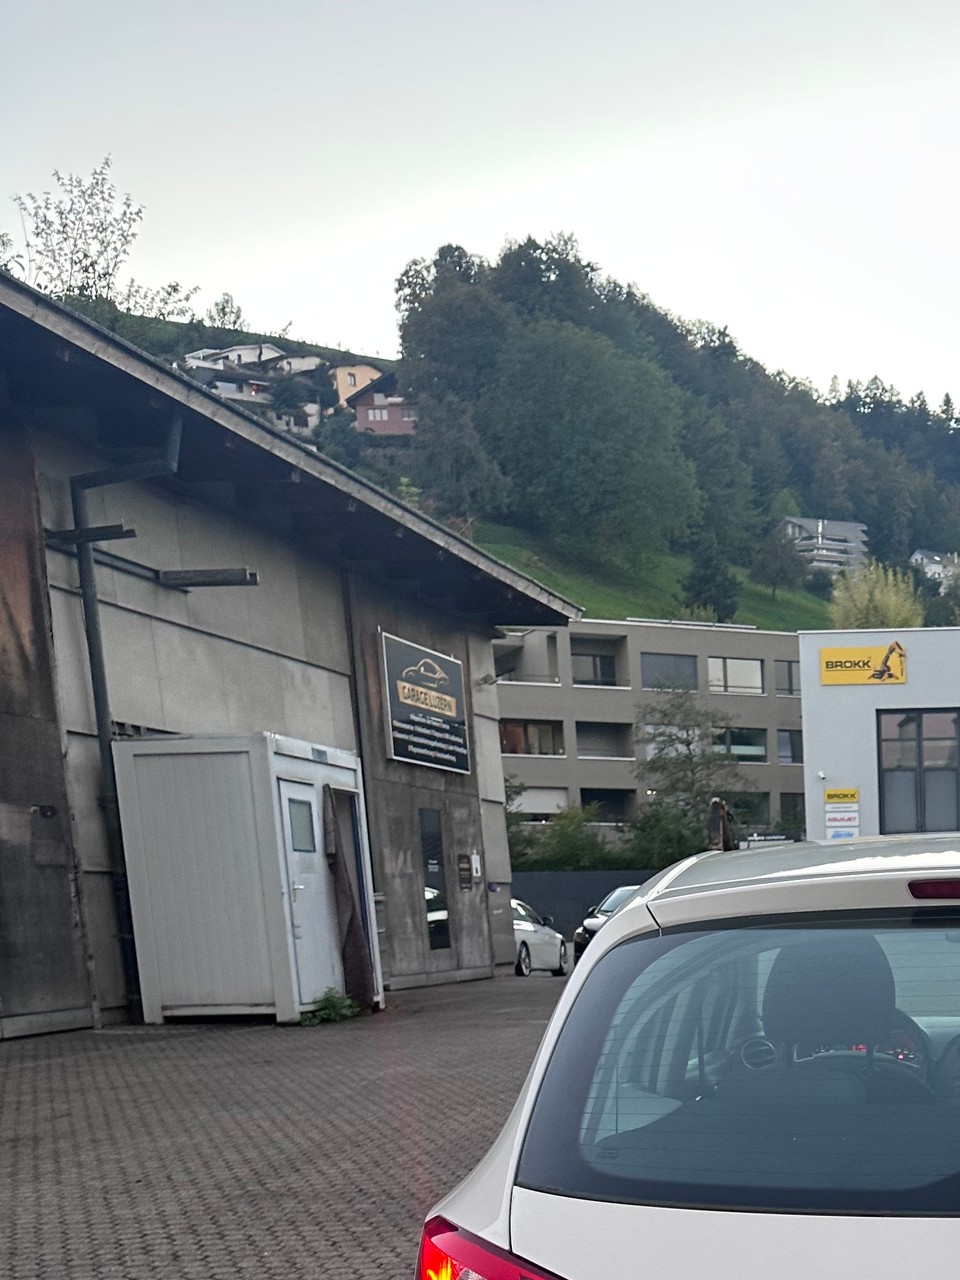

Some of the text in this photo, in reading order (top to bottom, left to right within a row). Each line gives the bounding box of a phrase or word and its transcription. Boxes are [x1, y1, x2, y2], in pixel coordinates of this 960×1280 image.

[825, 660, 871, 669] BROKK
[402, 685, 453, 713] GARAGE LUZERN
